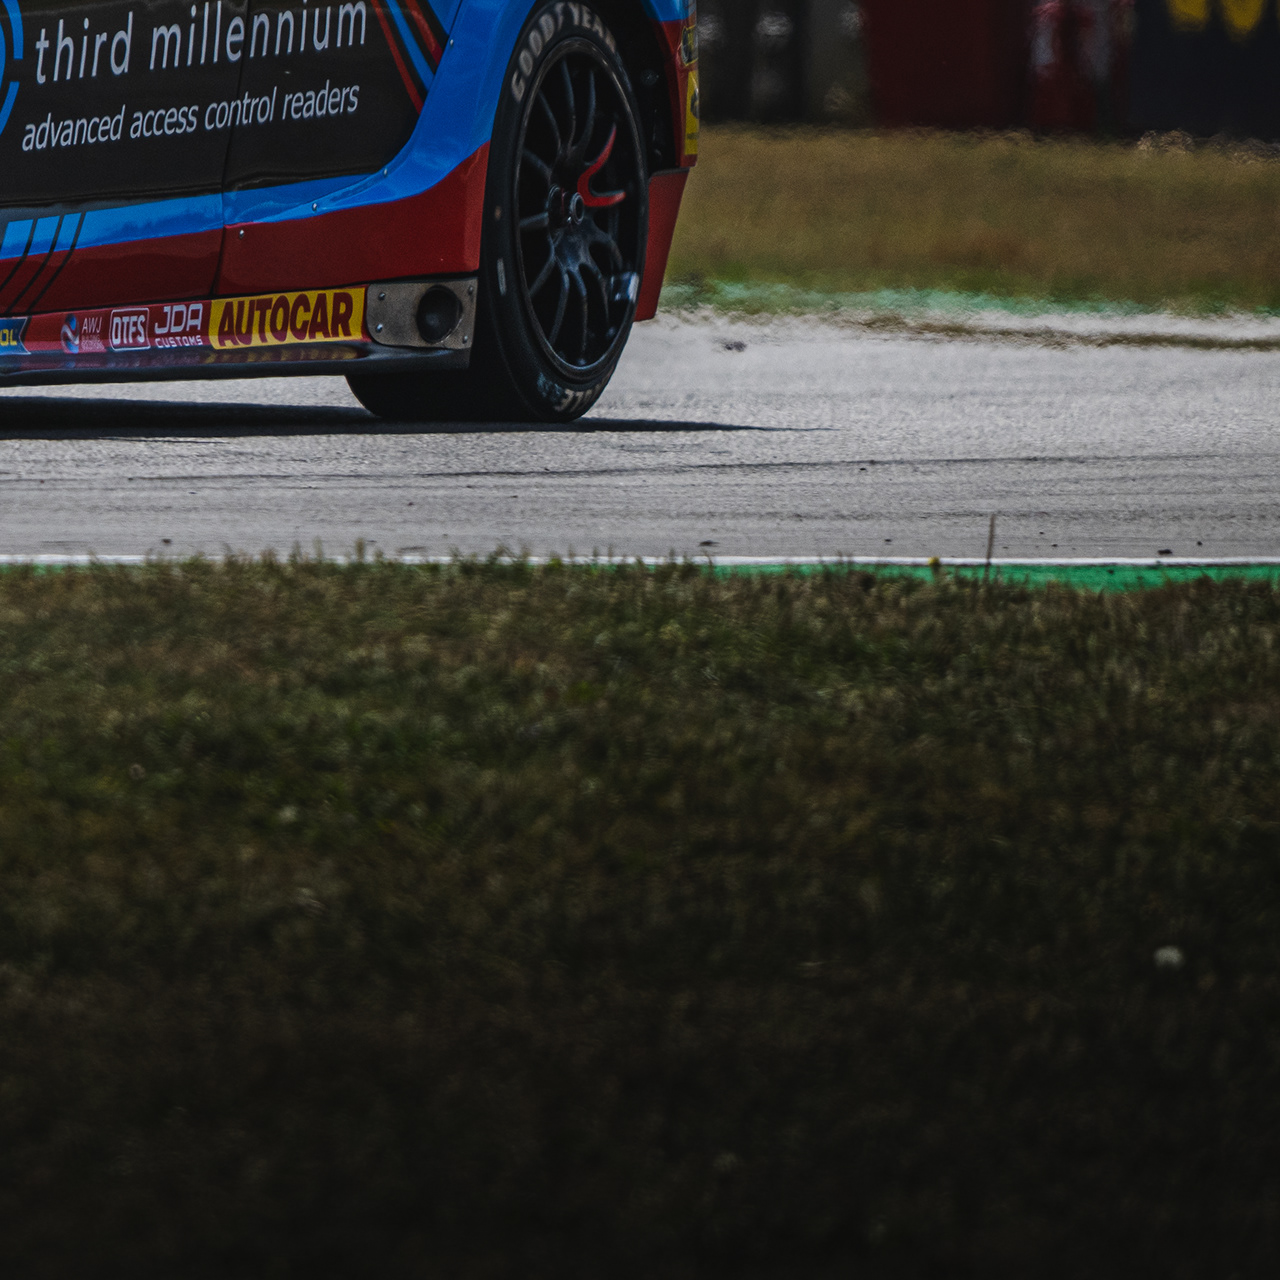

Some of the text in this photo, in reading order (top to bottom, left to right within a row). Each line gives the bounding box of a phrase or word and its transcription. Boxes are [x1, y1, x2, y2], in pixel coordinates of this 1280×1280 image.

[35, 11, 134, 85] third
[511, 1, 617, 104] GOODYEAR
[22, 79, 361, 151] advanced access control readers
[81, 316, 103, 333] AWJ
[154, 302, 203, 334] JDA
[155, 334, 204, 349] CUSTOMS
[218, 291, 354, 347] AUTOCAR
